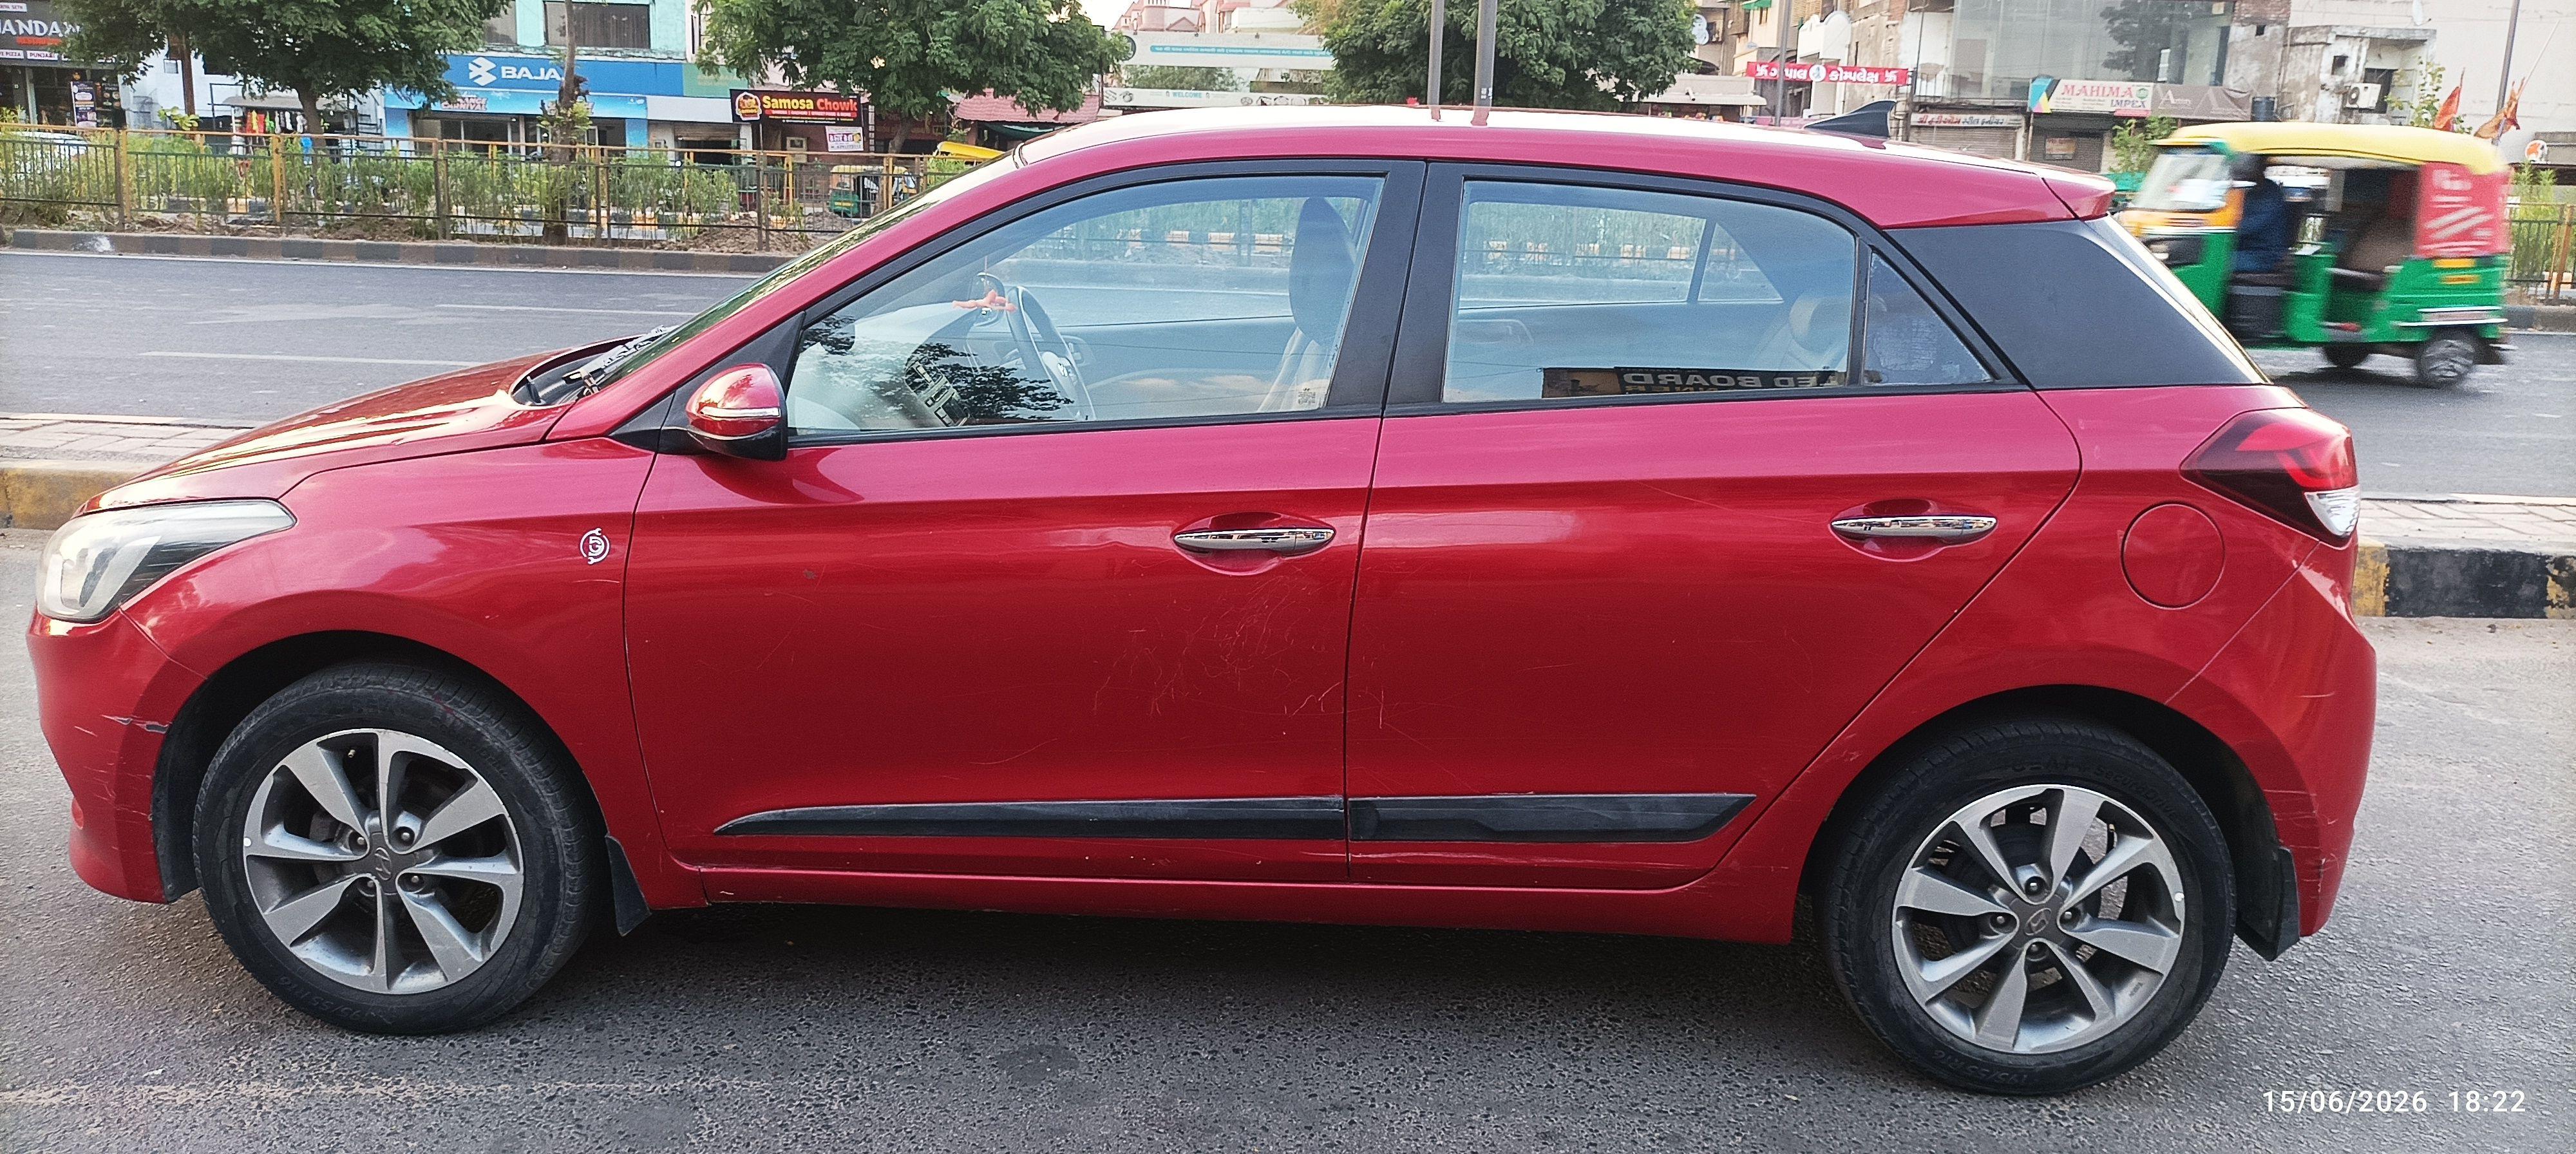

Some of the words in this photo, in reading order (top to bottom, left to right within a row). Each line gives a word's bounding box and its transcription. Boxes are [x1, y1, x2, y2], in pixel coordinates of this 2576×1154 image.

[501, 66, 563, 81] BAJA
[2061, 84, 2134, 98] MAHIMA
[762, 95, 815, 111] Samosa
[816, 98, 858, 111] Chowk
[2110, 99, 2146, 109] IMPEX
